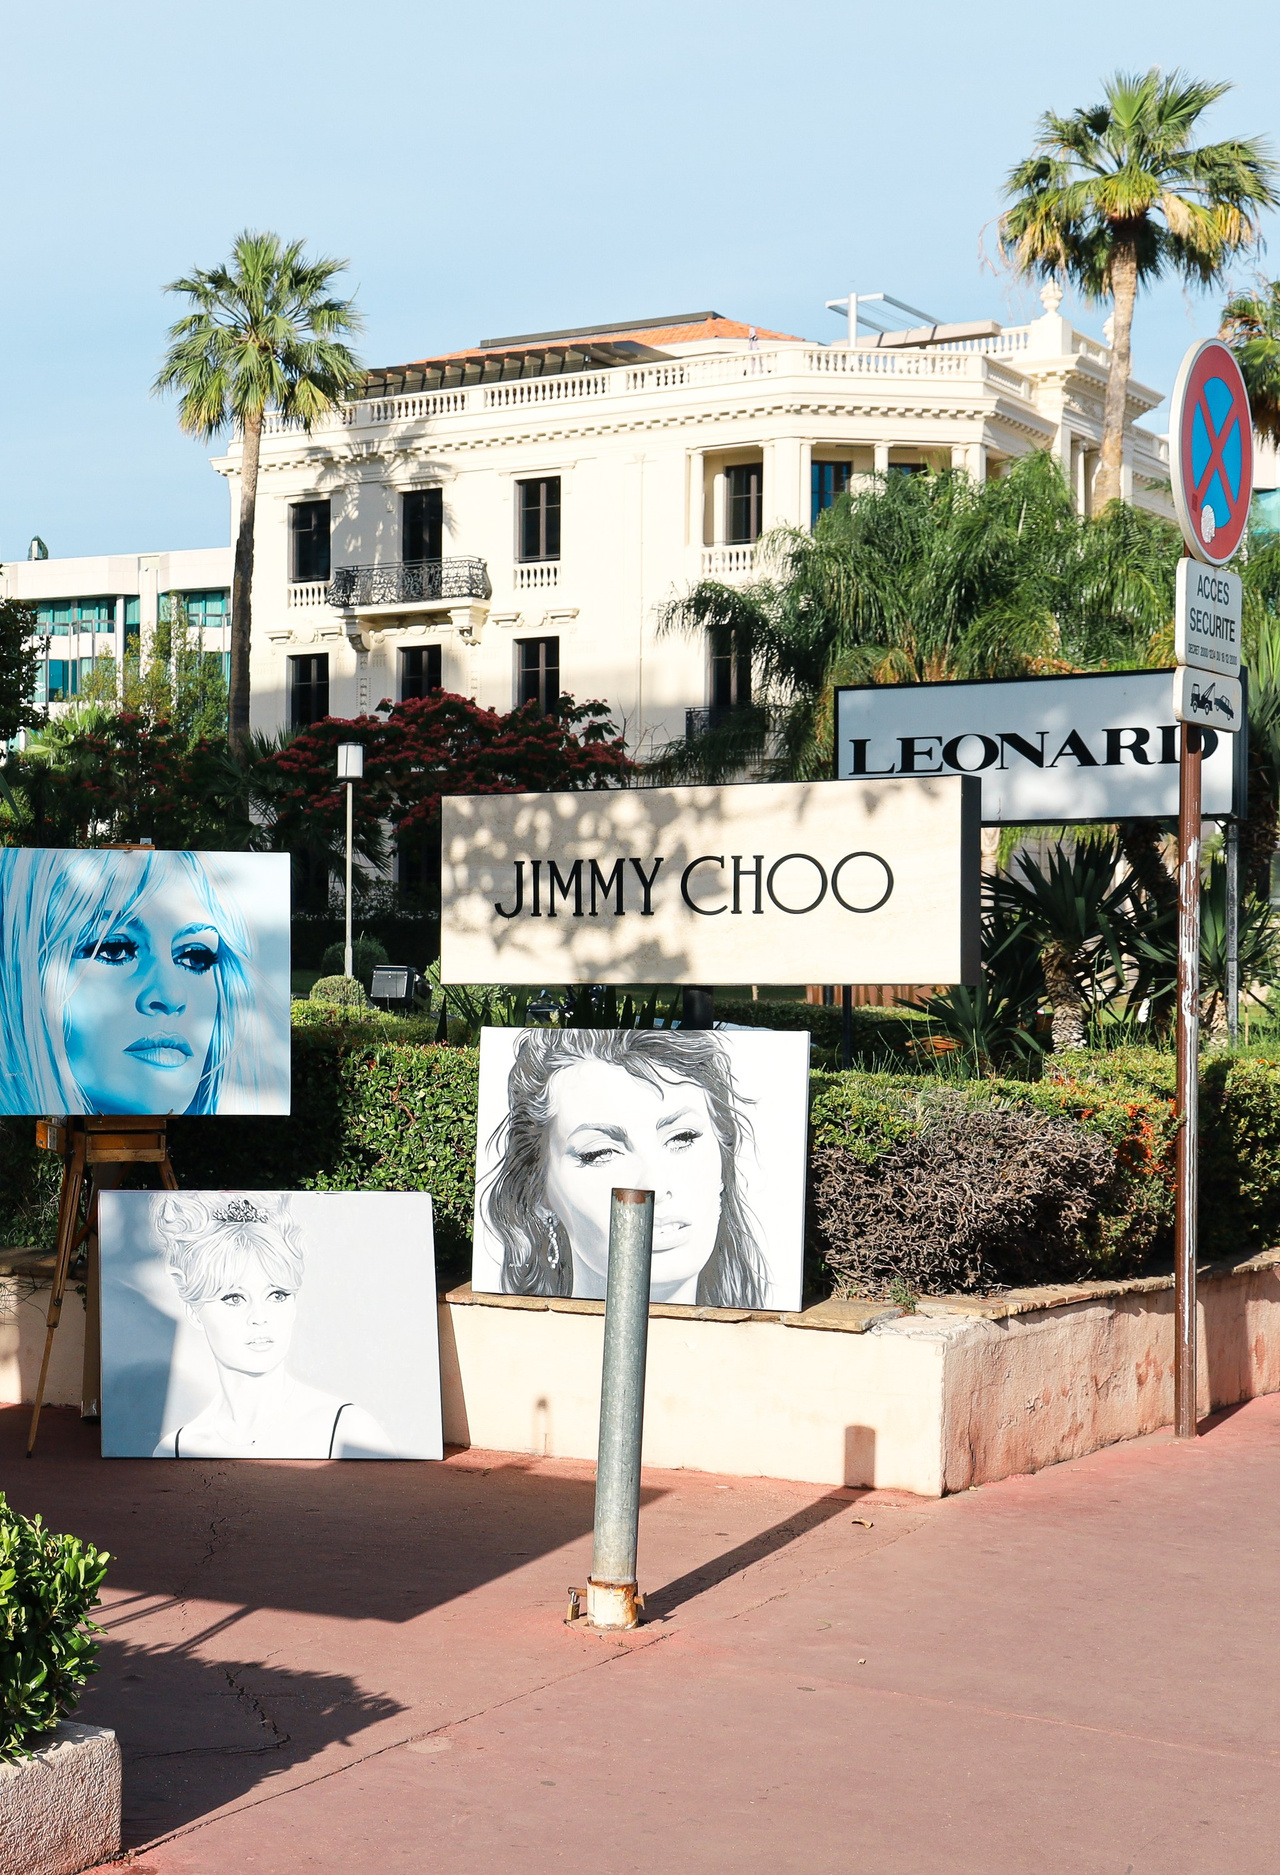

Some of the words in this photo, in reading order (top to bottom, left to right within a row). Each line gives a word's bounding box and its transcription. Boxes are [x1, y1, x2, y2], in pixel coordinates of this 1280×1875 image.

[1196, 574, 1230, 606] ACCES
[1189, 607, 1236, 643] SECURITE
[494, 856, 665, 919] JIMMY
[680, 851, 895, 916] CHOO
